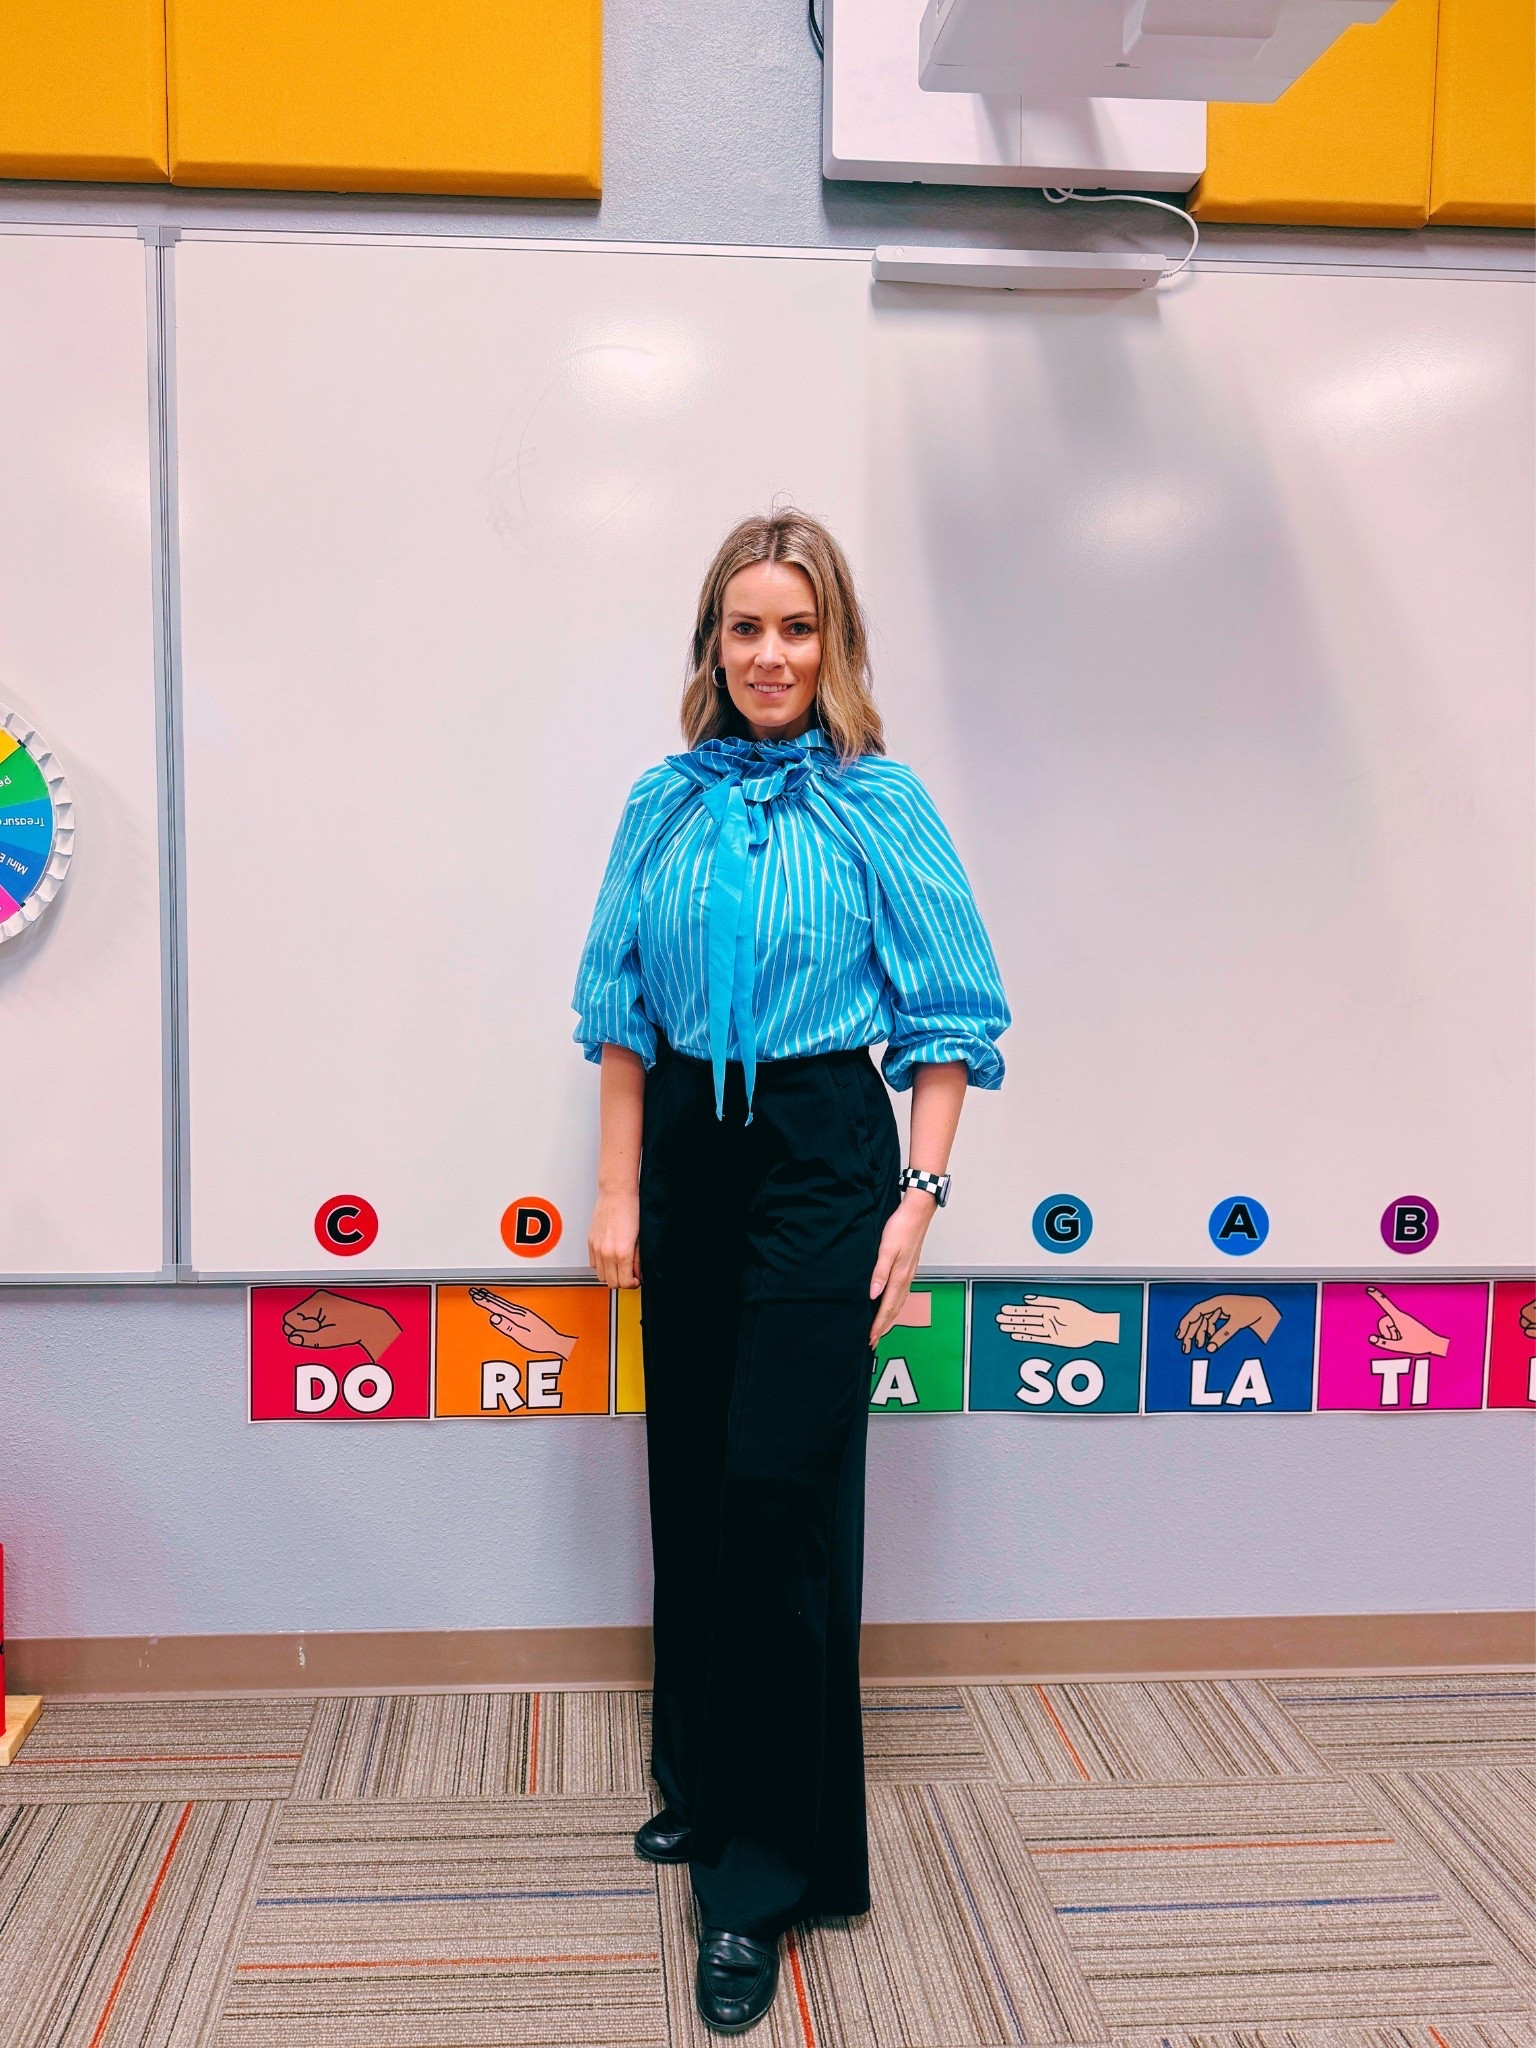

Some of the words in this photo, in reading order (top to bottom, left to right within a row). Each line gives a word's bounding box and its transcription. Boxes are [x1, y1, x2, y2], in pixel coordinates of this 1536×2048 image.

[8, 858, 29, 875] Mini
[326, 1205, 364, 1245] C
[515, 1207, 552, 1245] D
[1044, 1204, 1080, 1242] G
[1218, 1203, 1259, 1240] A
[1394, 1206, 1427, 1242] B
[294, 1363, 394, 1413] DO
[481, 1359, 562, 1412] RE
[870, 1357, 920, 1406] A
[1015, 1357, 1105, 1407] SO
[1190, 1358, 1273, 1407] LA
[1370, 1357, 1430, 1406] TI
